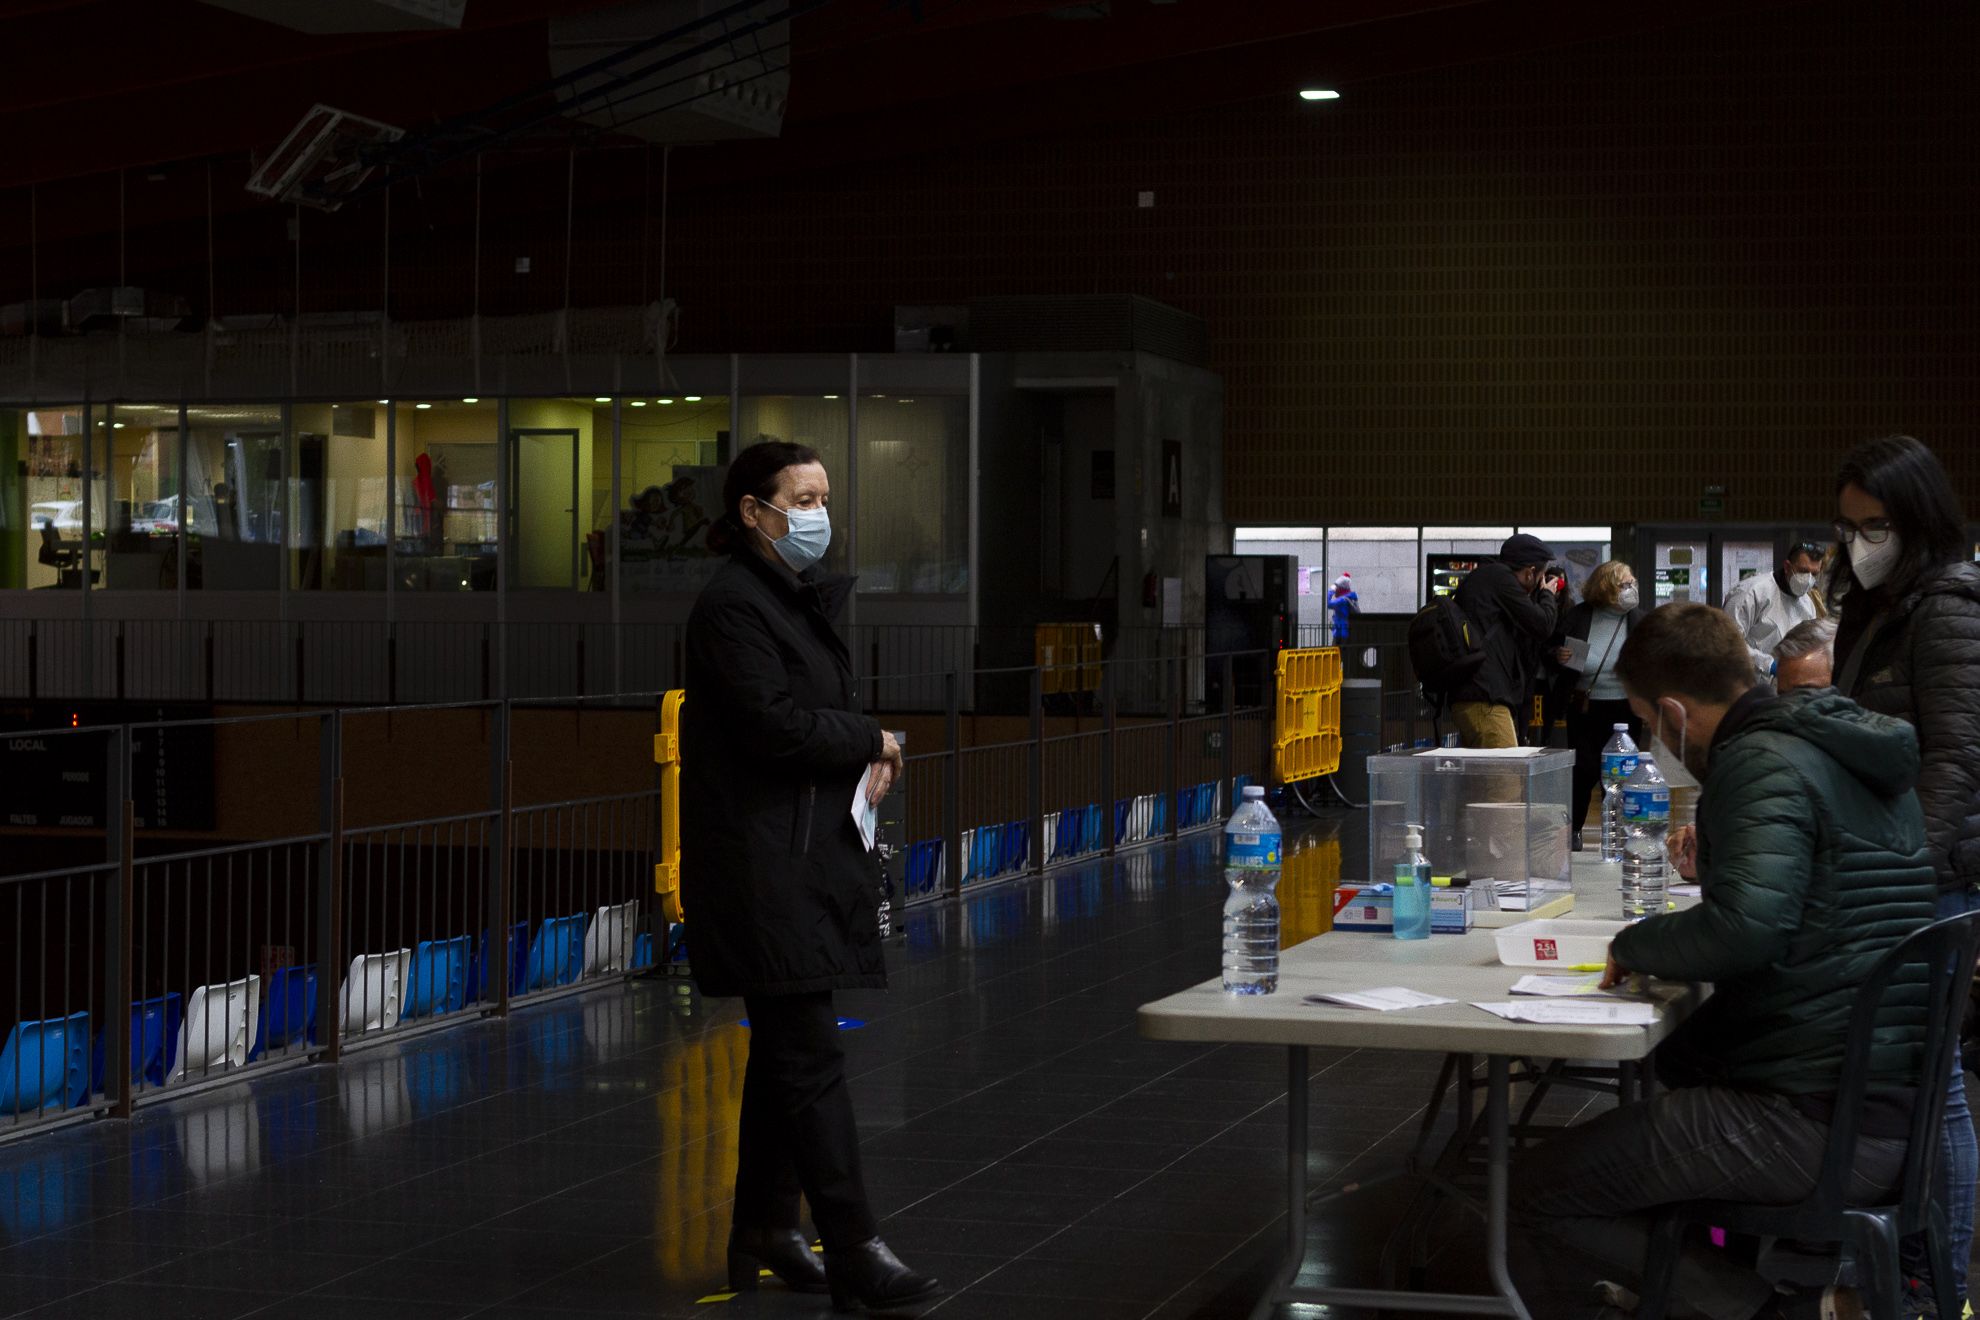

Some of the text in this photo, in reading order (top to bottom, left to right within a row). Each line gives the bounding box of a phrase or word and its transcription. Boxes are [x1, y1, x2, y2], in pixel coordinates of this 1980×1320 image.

[1168, 455, 1179, 504] A
[9, 738, 48, 752] LOCAL
[155, 767, 166, 776] 10
